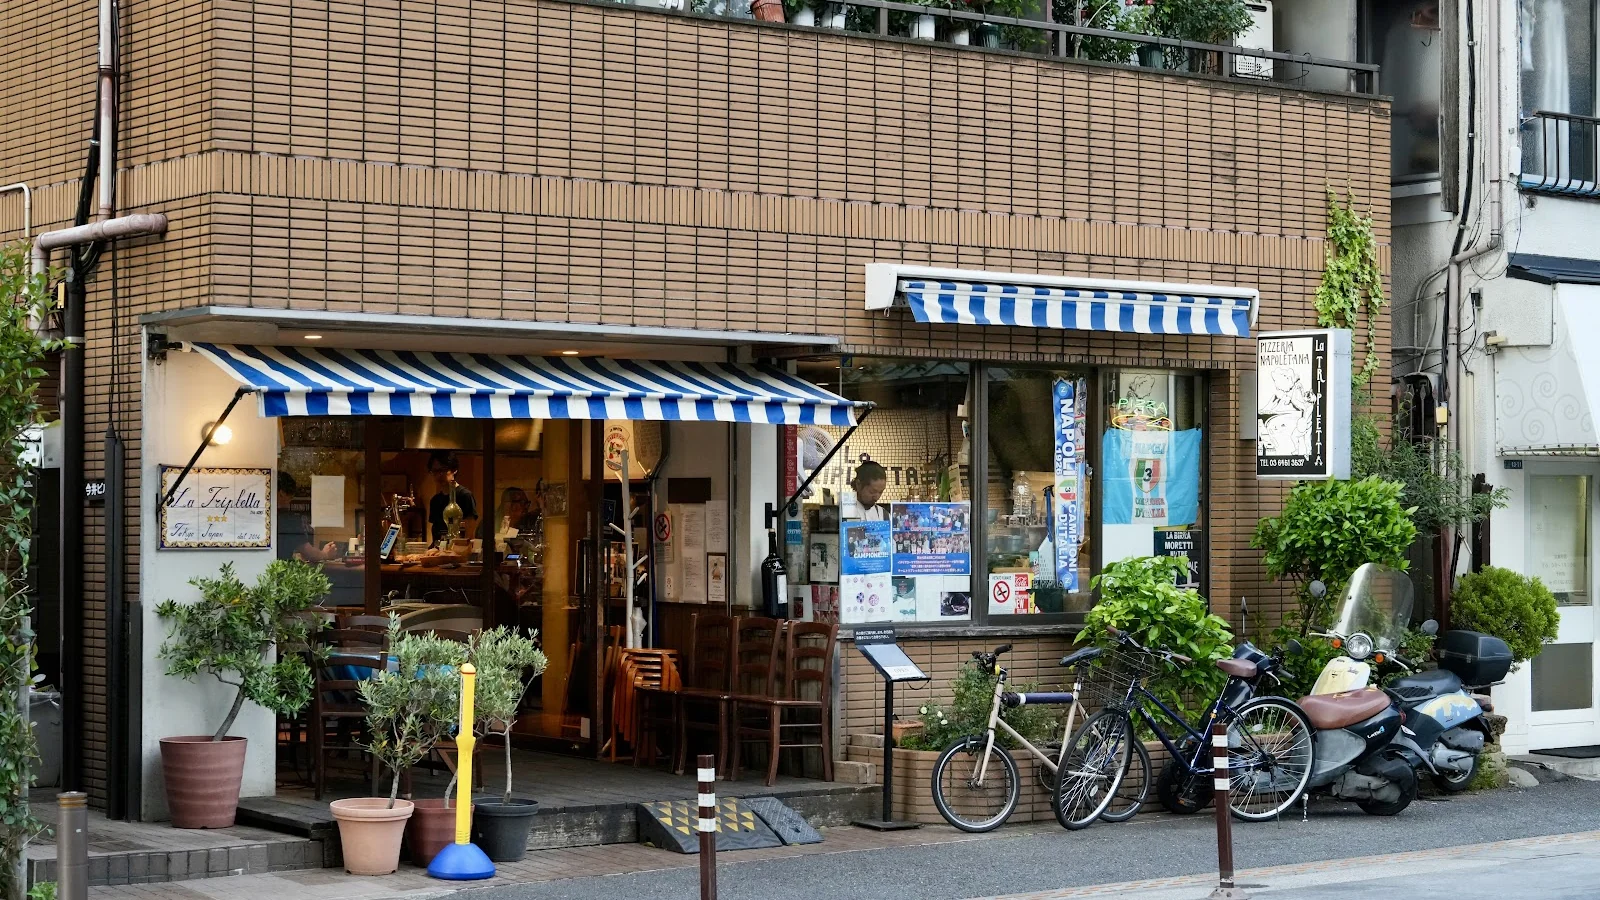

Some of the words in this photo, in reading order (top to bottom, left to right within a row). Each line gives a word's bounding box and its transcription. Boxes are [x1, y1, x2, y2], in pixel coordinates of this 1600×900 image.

[1260, 341, 1294, 354] PIZZERIA
[1315, 340, 1325, 352] La
[1260, 353, 1310, 366] NAPOLETANA
[1117, 398, 1168, 416] PIZZA
[1314, 355, 1326, 467] TRIPLETTA
[1060, 398, 1076, 477] NAPOLI
[1260, 458, 1269, 467] TEL
[1270, 458, 1277, 467] 03
[1143, 468, 1153, 481] 3
[171, 486, 195, 508] La
[201, 486, 260, 515] Tripletta
[171, 522, 195, 540] Tokyo
[201, 523, 223, 540] Japan
[1068, 504, 1077, 573] CAMPIONI
[1165, 531, 1174, 540] LA
[1058, 513, 1068, 569] D'ITALIA
[1164, 541, 1194, 550] MORETTI
